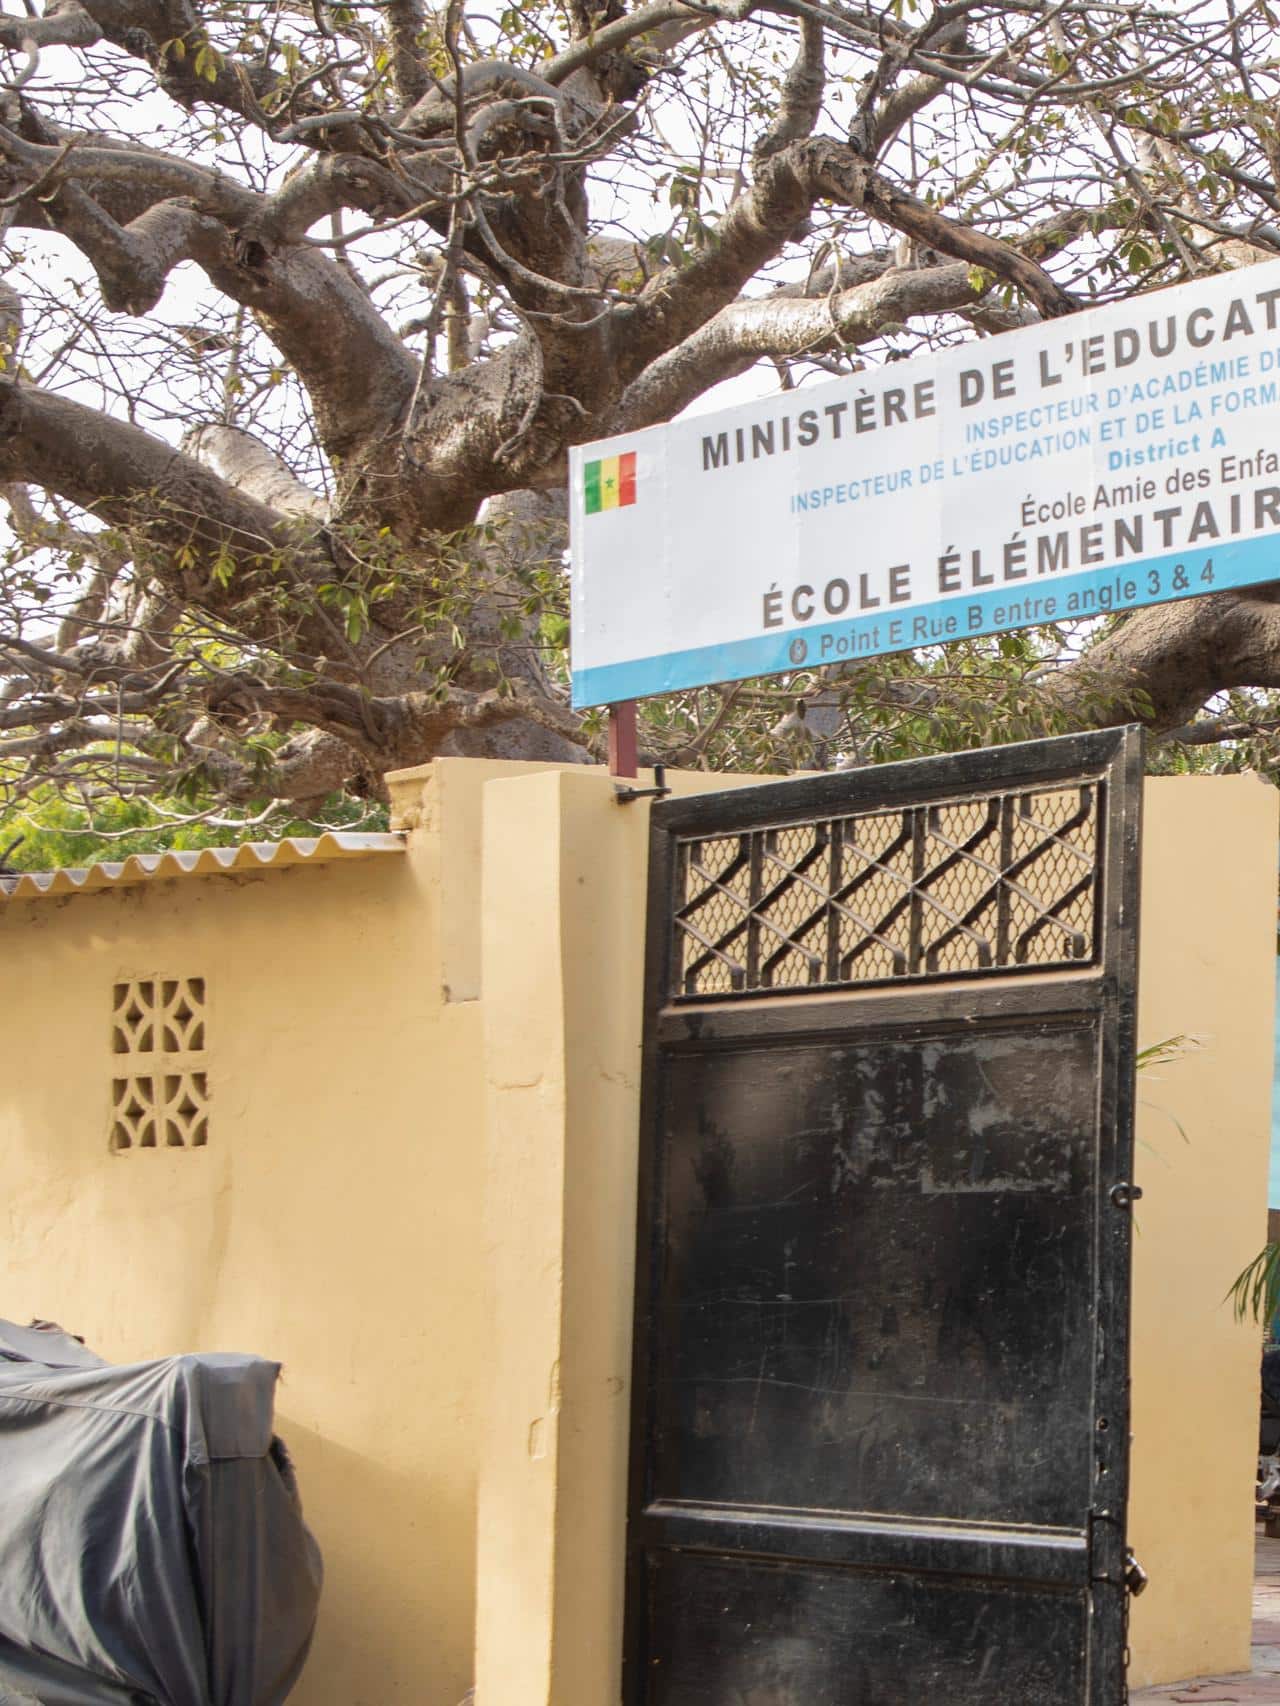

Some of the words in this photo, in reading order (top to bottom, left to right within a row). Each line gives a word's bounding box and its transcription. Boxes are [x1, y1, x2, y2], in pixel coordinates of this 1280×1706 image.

[702, 379, 936, 472] MINISTÈRE
[959, 359, 1016, 408] DE
[966, 393, 1098, 444] INSPECTEUR
[1108, 355, 1249, 410] D'ACADÉMIE
[790, 469, 912, 514] INSPECTEUR
[920, 459, 944, 485] DE
[953, 426, 1091, 477] L'ÉDUCATION
[1101, 418, 1127, 442] ET
[1136, 409, 1165, 434] DE
[1174, 400, 1202, 426] LA
[1109, 433, 1200, 471] District
[1211, 427, 1226, 449] A
[1022, 494, 1086, 528] École
[1093, 474, 1156, 512] Amie
[1166, 467, 1211, 495] des
[763, 564, 911, 629] ÉCOLE
[820, 629, 880, 658] Point
[890, 621, 903, 644] E
[913, 615, 957, 641] Rue
[968, 605, 983, 630] B
[993, 592, 1057, 623] entre
[1068, 576, 1137, 611] angle
[1148, 569, 1160, 595] 3
[1172, 565, 1189, 590] &
[1201, 559, 1215, 584] 4
